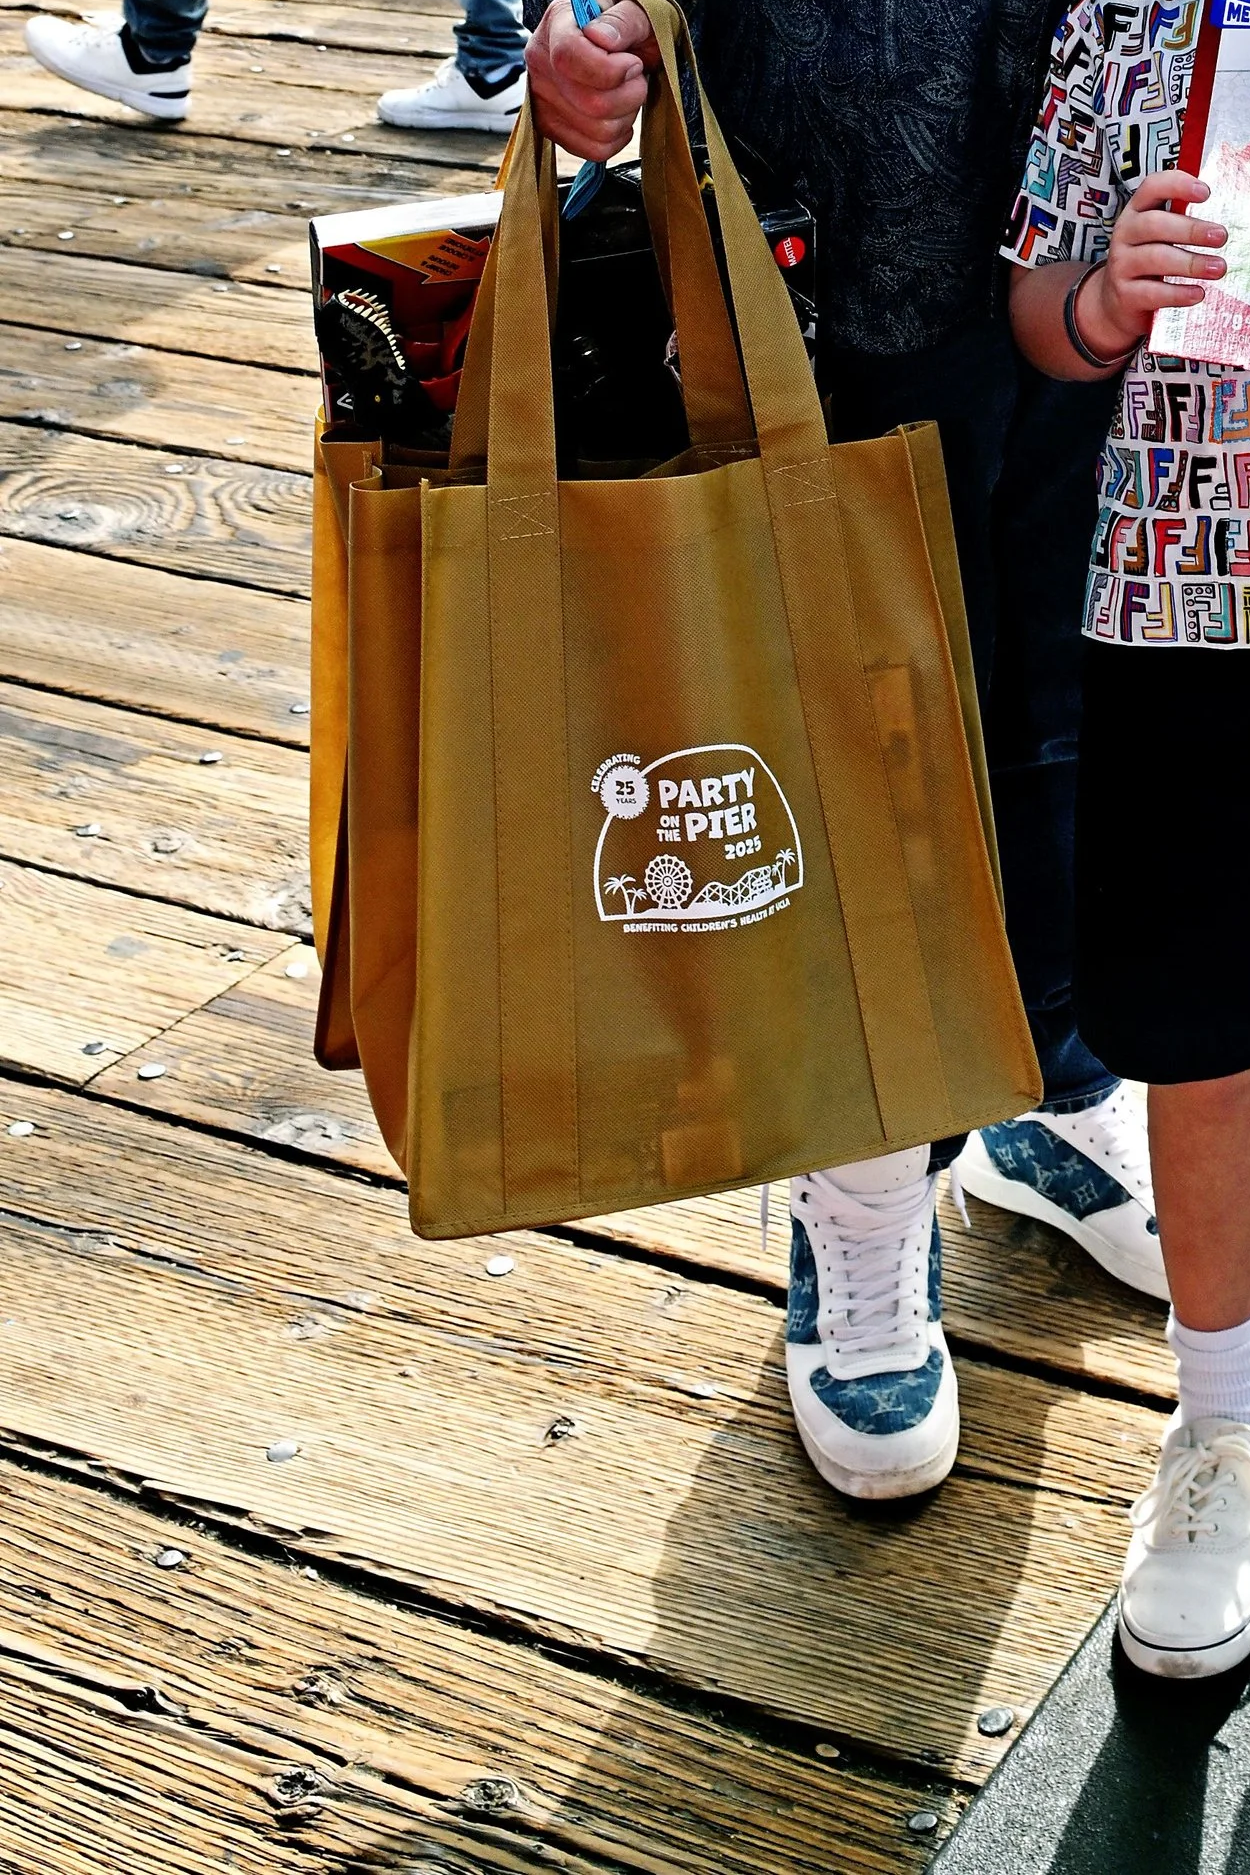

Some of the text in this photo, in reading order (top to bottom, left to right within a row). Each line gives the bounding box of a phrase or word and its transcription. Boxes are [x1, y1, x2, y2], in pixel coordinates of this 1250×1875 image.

[782, 237, 798, 267] MATTEL
[590, 753, 641, 793] CELEBRATING
[615, 780, 636, 796] 25
[658, 766, 755, 809] PARTY
[616, 797, 637, 805] YEARS
[656, 828, 681, 842] THE
[660, 802, 757, 842] ON PIER
[724, 835, 762, 860] 2025
[623, 898, 791, 933] BENEFITING CHILDREN'S HEALTH AT UCLA
